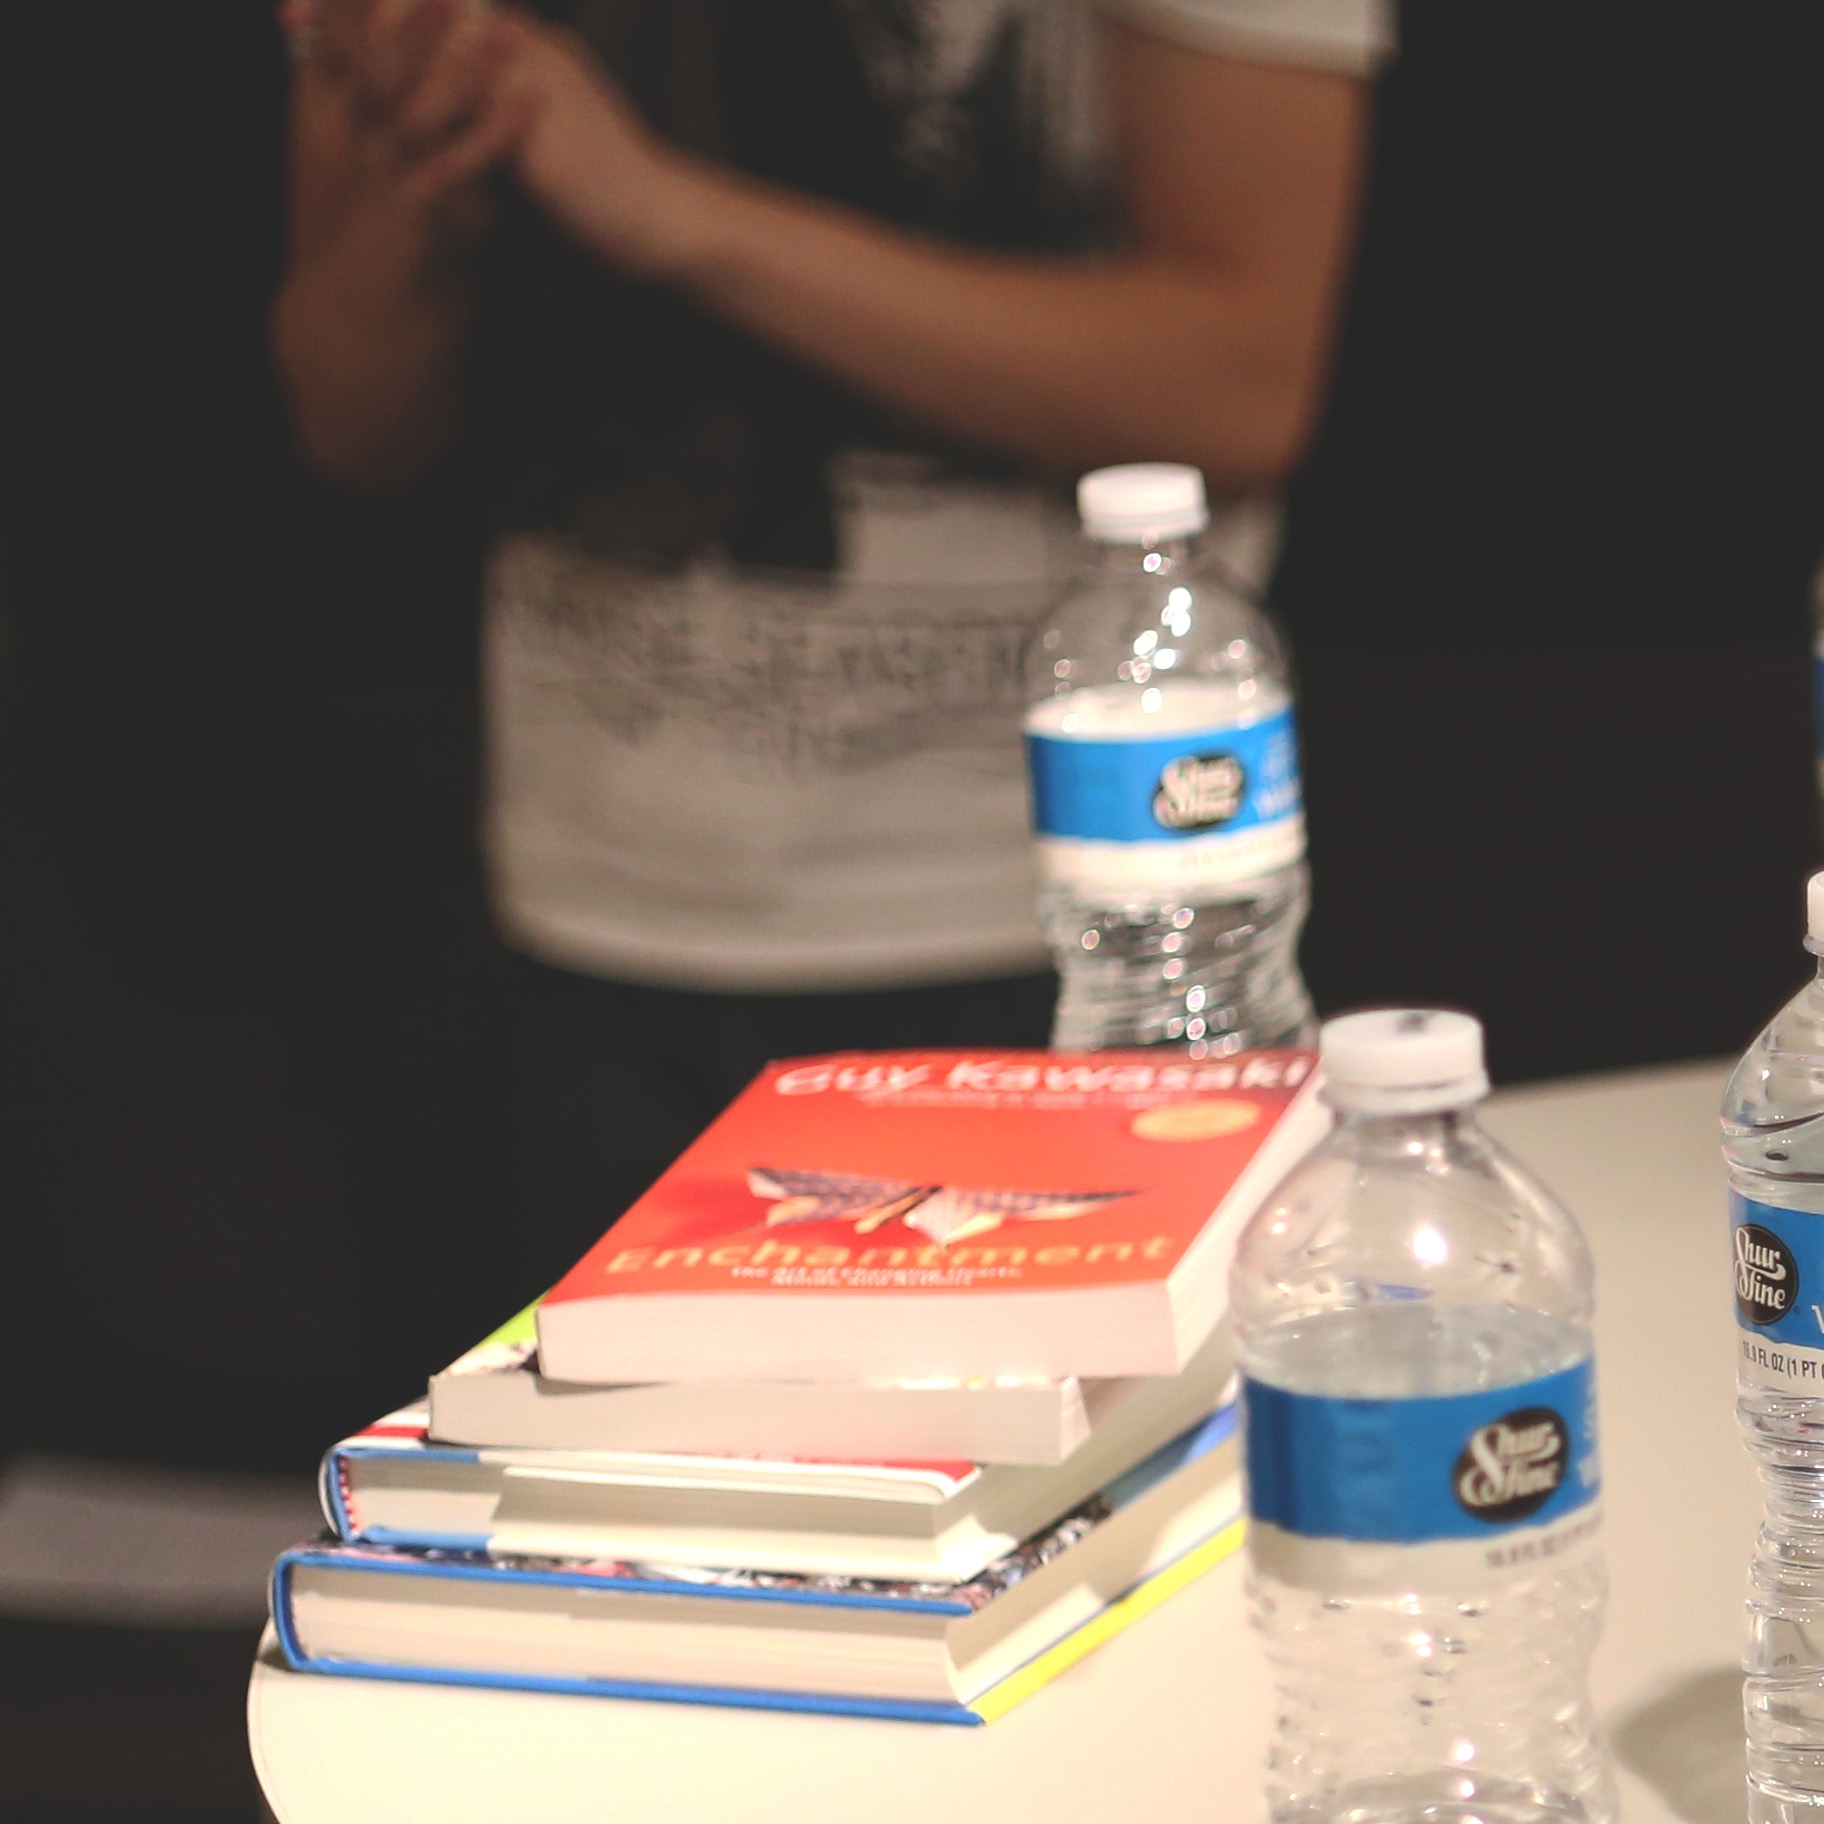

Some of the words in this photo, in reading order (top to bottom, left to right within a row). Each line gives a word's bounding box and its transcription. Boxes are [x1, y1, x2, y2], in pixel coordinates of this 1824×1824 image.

[605, 1235, 1175, 1275] Enchantment
[1758, 1348, 1770, 1368] FL
[1771, 1352, 1785, 1373] OZ
[1787, 1357, 1797, 1379] (1
[1801, 1360, 1818, 1379] PT
